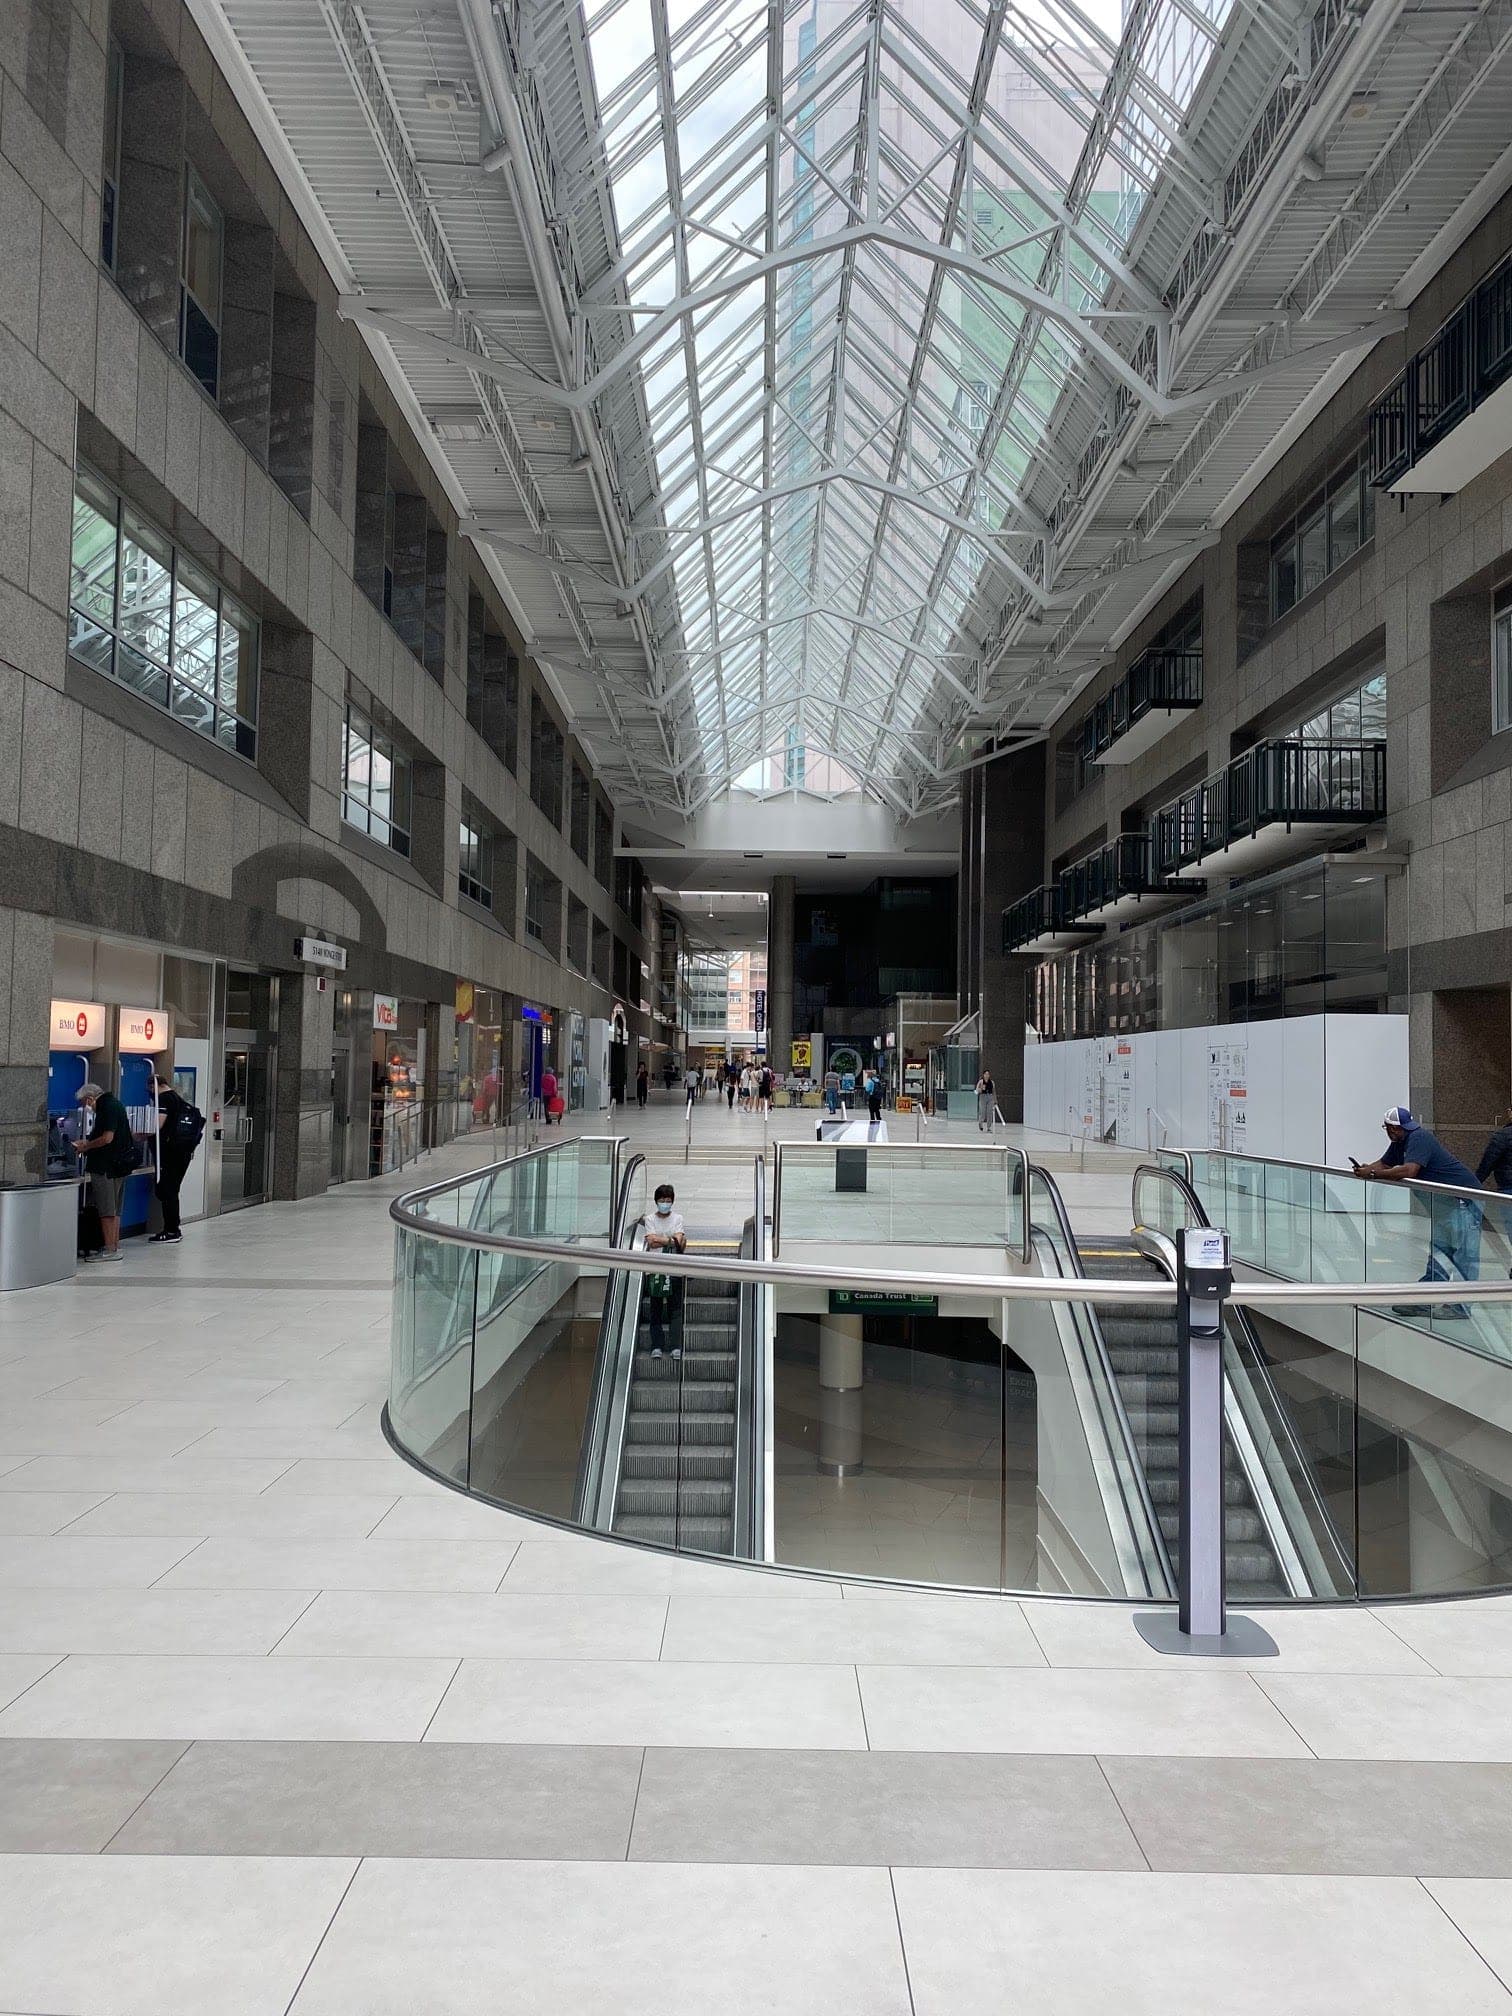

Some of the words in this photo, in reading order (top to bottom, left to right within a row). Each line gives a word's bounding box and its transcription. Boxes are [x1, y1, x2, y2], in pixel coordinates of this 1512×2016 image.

[59, 1020, 75, 1030] BMO
[131, 1024, 144, 1033] BMO
[839, 1292, 849, 1301] TD
